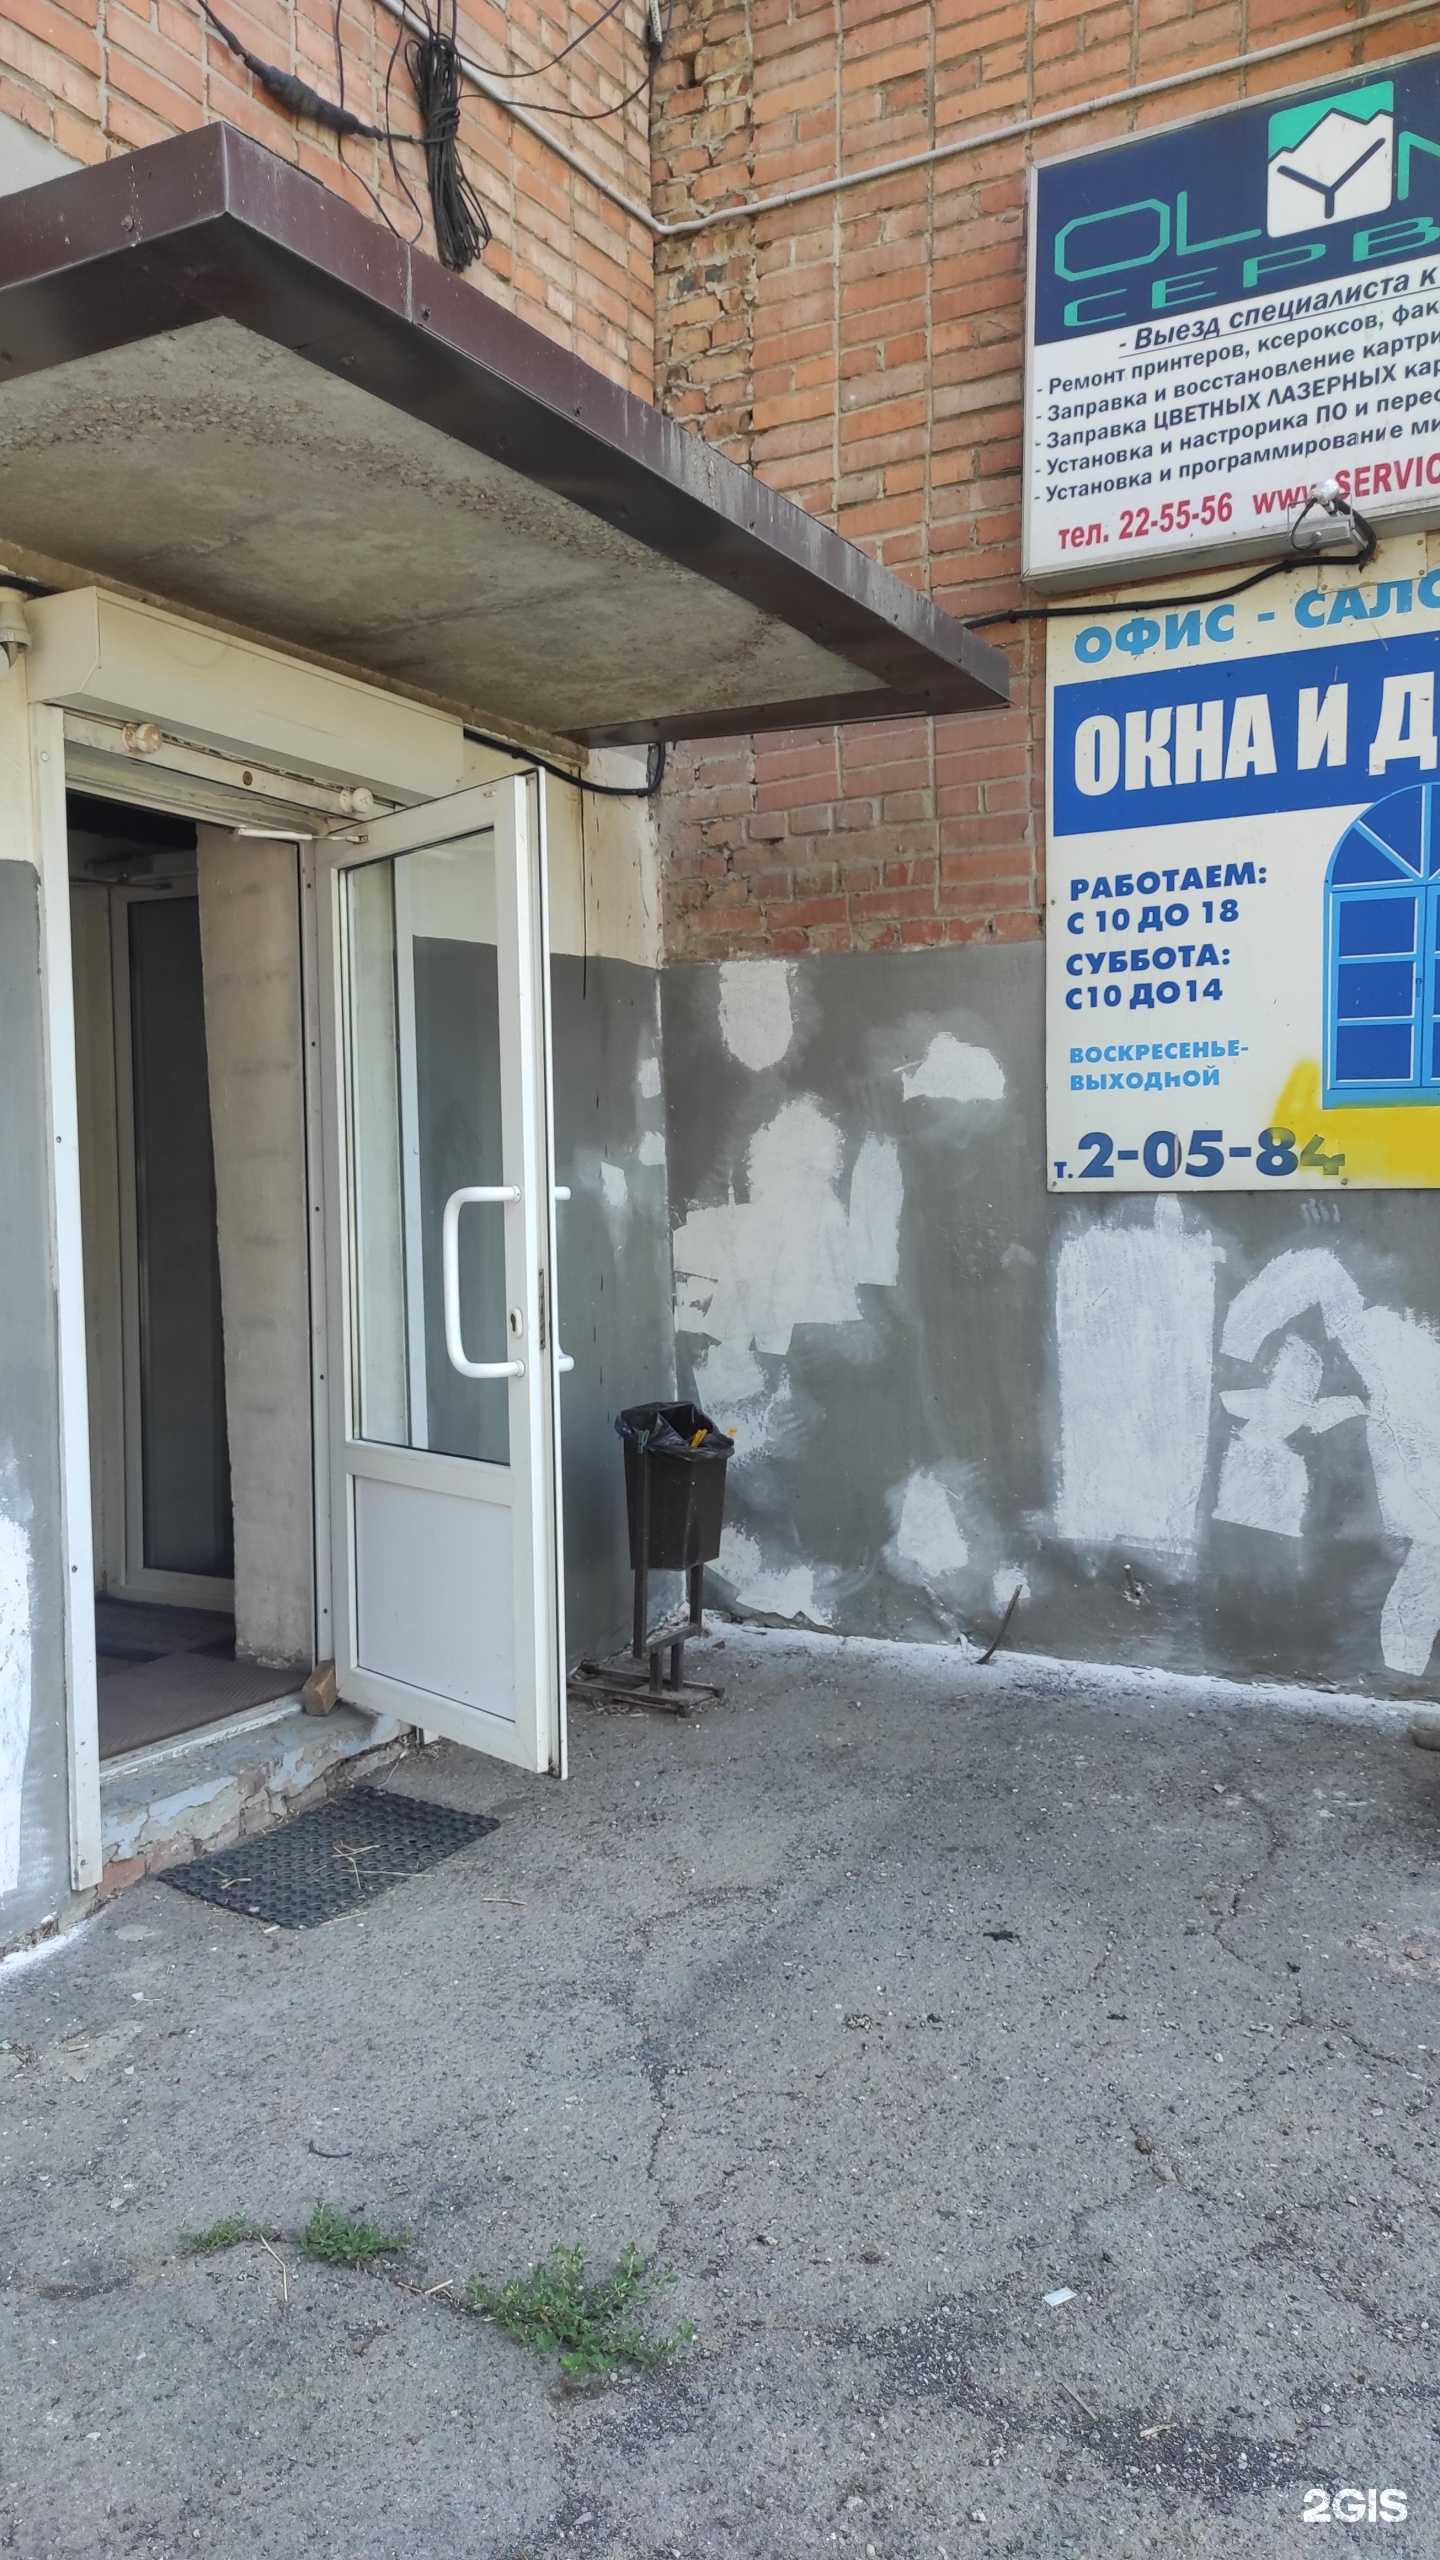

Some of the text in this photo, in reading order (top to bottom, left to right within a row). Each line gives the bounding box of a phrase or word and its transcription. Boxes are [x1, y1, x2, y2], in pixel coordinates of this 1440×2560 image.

[1134, 317, 1220, 350] Выезд
[1229, 274, 1410, 329] специалиста
[1420, 266, 1438, 287] к
[1048, 368, 1126, 395] Ремонт
[1131, 343, 1250, 380] принтеров,
[1257, 314, 1384, 352] ксероксов,
[1392, 300, 1439, 326] фак
[1047, 391, 1147, 421] Заправка
[1154, 388, 1166, 402] и
[1173, 348, 1355, 398] восстановление
[1047, 419, 1146, 449] Заправка
[1154, 391, 1261, 430] ЦВЕТНЫХ
[1267, 363, 1396, 407] ЛАЗЕРНЫХ
[1046, 445, 1153, 475] Установка
[1160, 440, 1172, 454] и
[1179, 413, 1308, 451] настрорика
[1316, 402, 1348, 425] ПО
[1355, 402, 1368, 417] и
[1046, 472, 1152, 503] Установка
[1159, 468, 1171, 482] и
[1179, 424, 1403, 480] программирование
[1058, 523, 1109, 550] тел.
[1118, 491, 1233, 540] 22-55-56
[1073, 604, 1236, 663] ОФИС
[1074, 671, 1438, 796] ОКНА И Д
[1070, 861, 1267, 901] РАБОТАЕМ:
[1066, 899, 1239, 934] С 10 ДО 18
[1066, 943, 1231, 976] СУББОТА:
[1069, 1039, 1249, 1064] ВОСКРЕСЕНЬЕ-
[1070, 1065, 1220, 1092] ВЫХОДНОЙ
